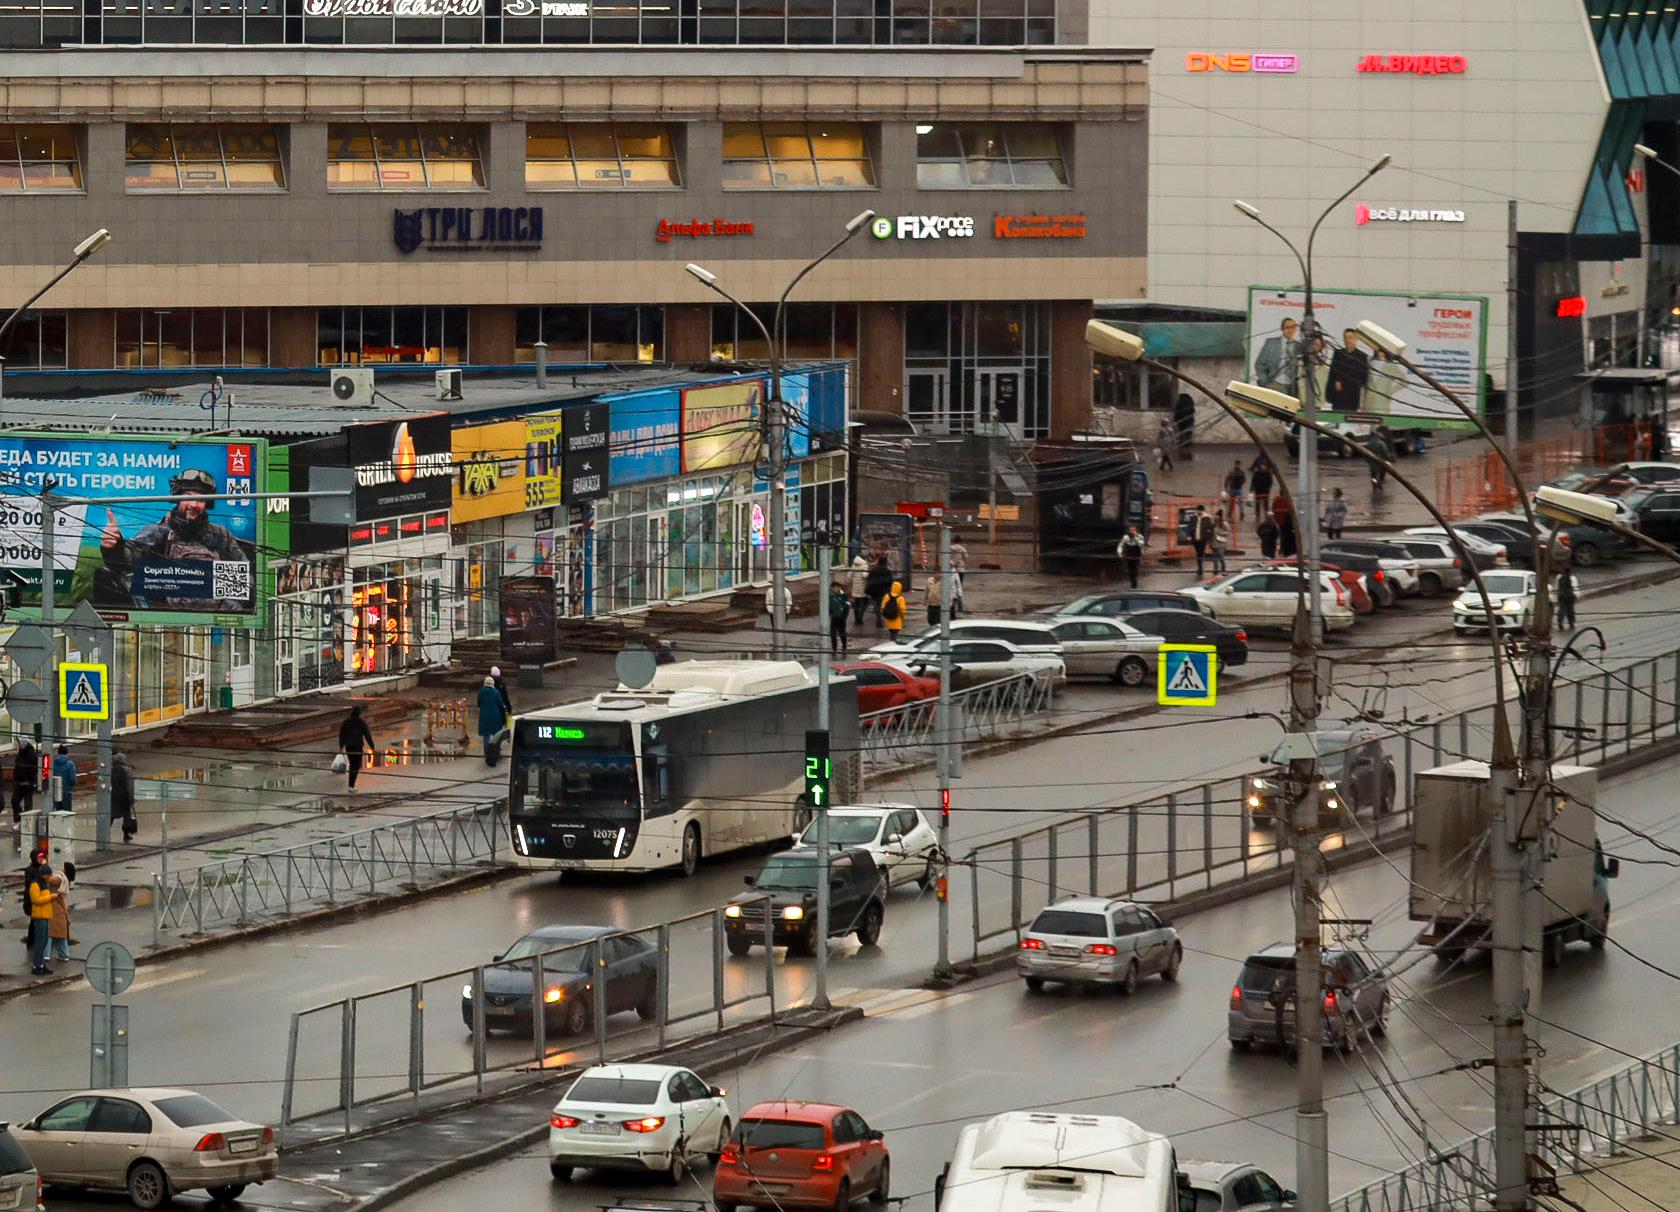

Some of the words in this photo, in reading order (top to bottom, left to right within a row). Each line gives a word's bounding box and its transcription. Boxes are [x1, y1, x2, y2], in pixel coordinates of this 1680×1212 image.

[1186, 54, 1250, 72] DNS
[427, 207, 472, 241] ТРИ
[480, 207, 543, 241] ЛОСЯ
[36, 450, 93, 467] БУДЕТ
[96, 453, 119, 468] ЗА
[123, 453, 181, 469] НАМИ!
[81, 473, 156, 490] ГЕРОЕМ!
[806, 757, 830, 779] 21
[593, 830, 617, 839] 12075
